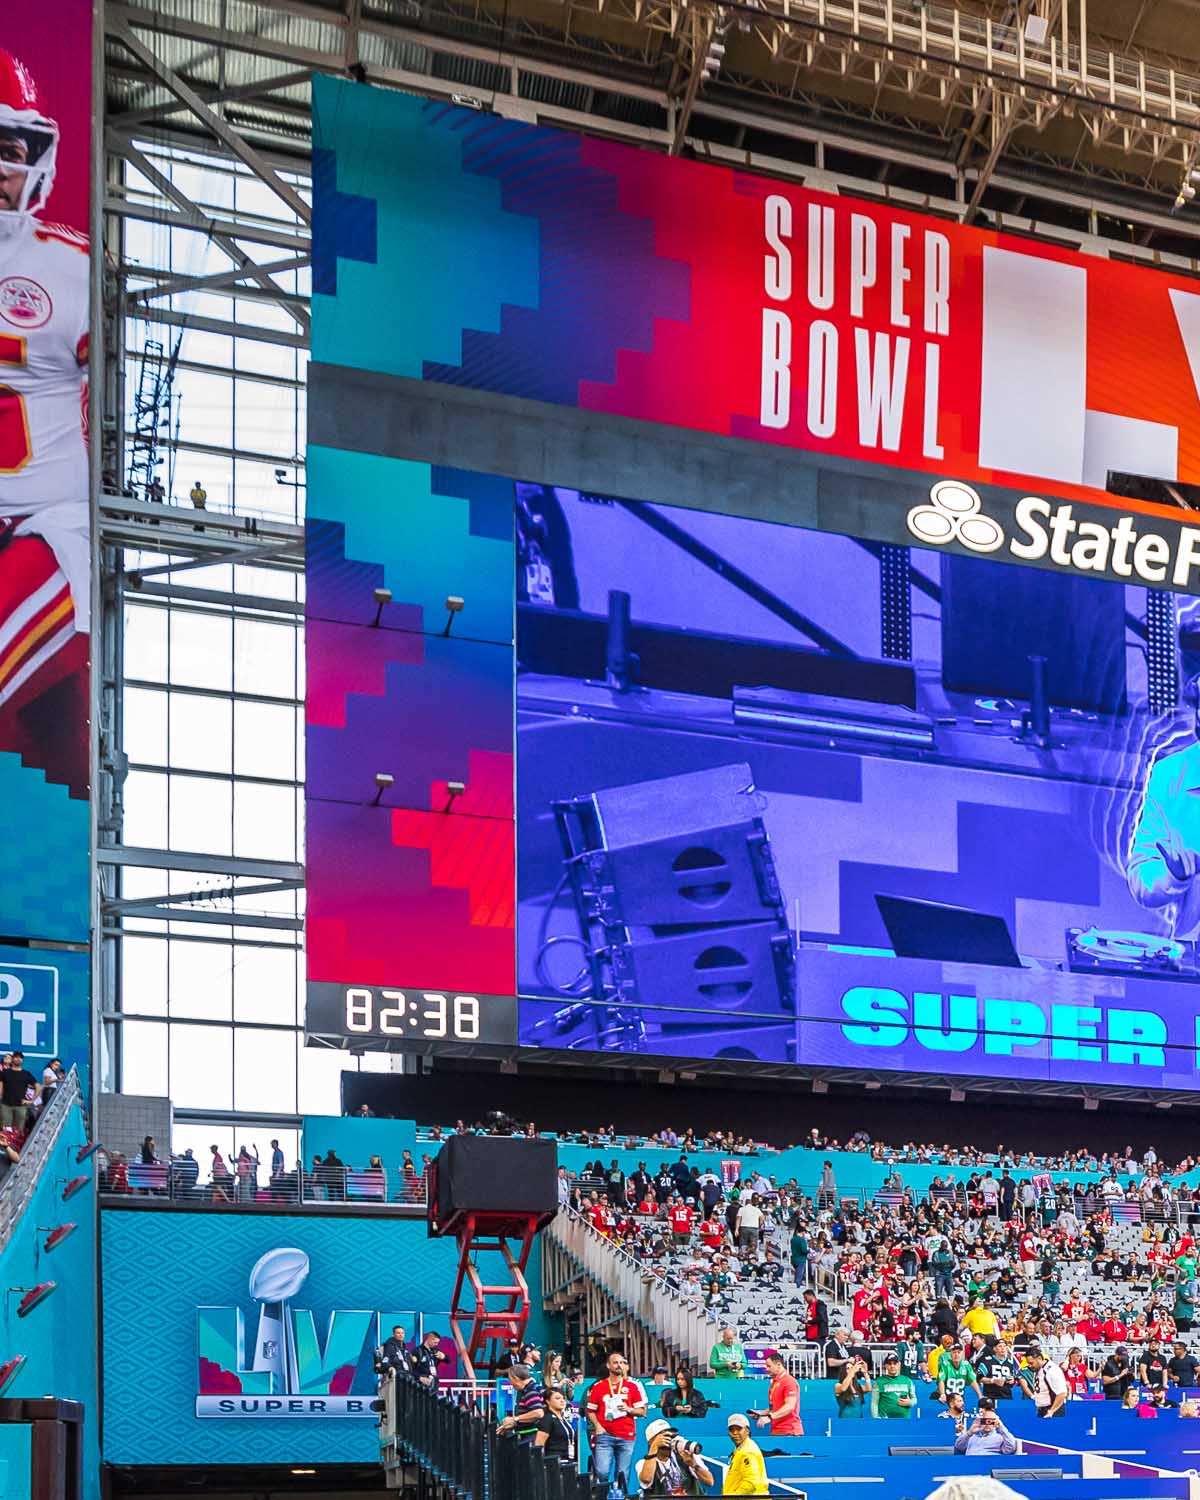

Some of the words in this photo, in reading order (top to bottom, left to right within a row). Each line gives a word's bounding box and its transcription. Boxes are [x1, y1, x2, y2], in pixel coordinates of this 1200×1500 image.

[762, 194, 951, 336] SUPER
[760, 308, 946, 461] BOWL
[346, 988, 479, 1039] 82:38
[840, 986, 1169, 1068] SUPER
[675, 1209, 688, 1221] 15
[1045, 1199, 1056, 1209] 20
[945, 1378, 966, 1395] 92
[219, 1400, 327, 1413] SUPER
